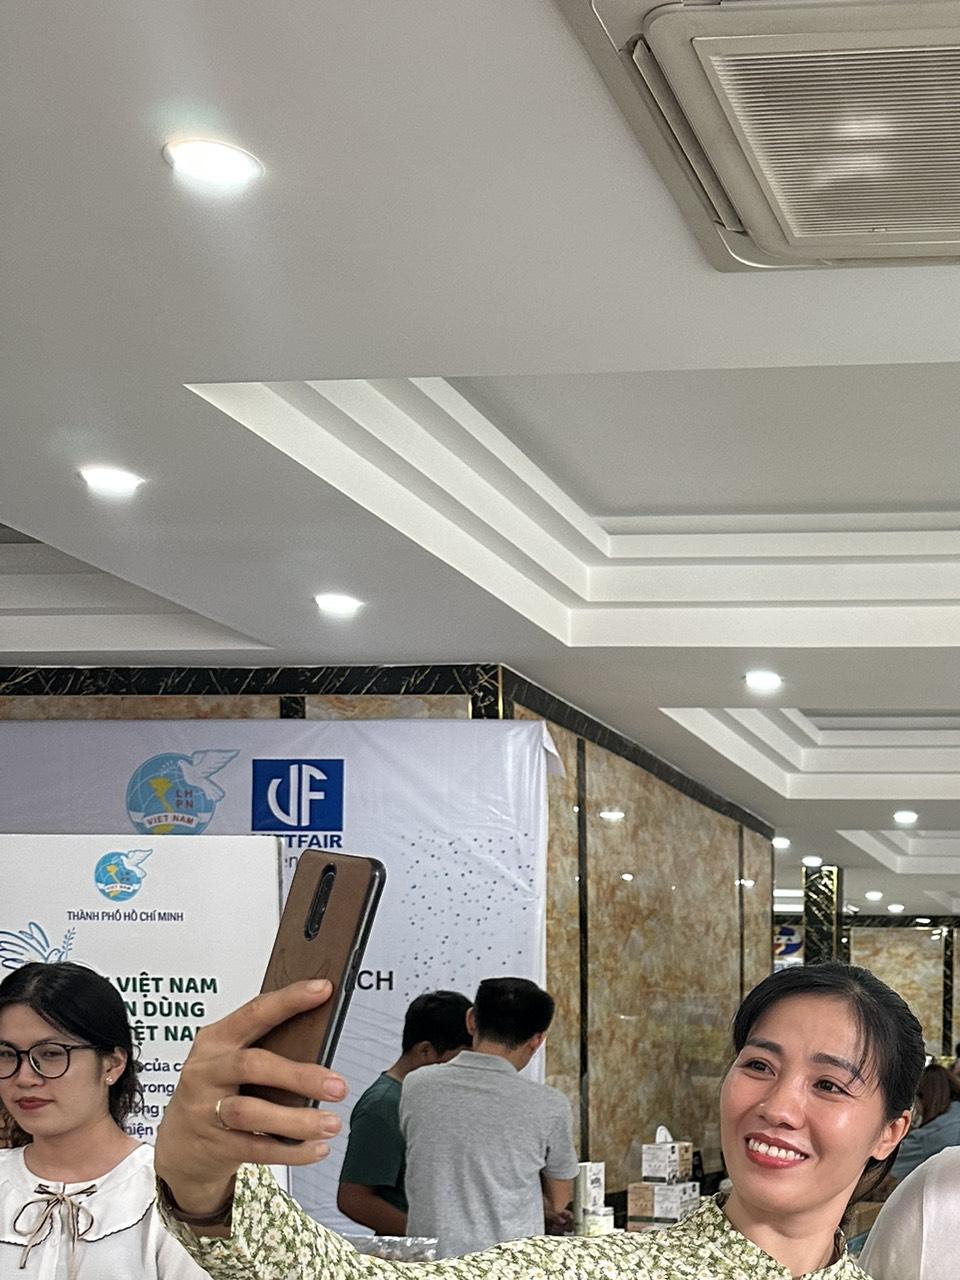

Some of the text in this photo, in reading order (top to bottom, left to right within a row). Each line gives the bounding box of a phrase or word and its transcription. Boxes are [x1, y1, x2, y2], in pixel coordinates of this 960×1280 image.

[67, 909, 100, 922] THÀNH
[139, 909, 157, 922] CHÍ
[158, 912, 184, 922] MINH
[116, 971, 218, 998] VIỆT NAM
[357, 969, 394, 991] CH
[143, 995, 205, 1018] DÙNG
[134, 1019, 201, 1046] ỆT NA
[143, 1057, 171, 1072] của
[143, 1083, 175, 1097] rong
